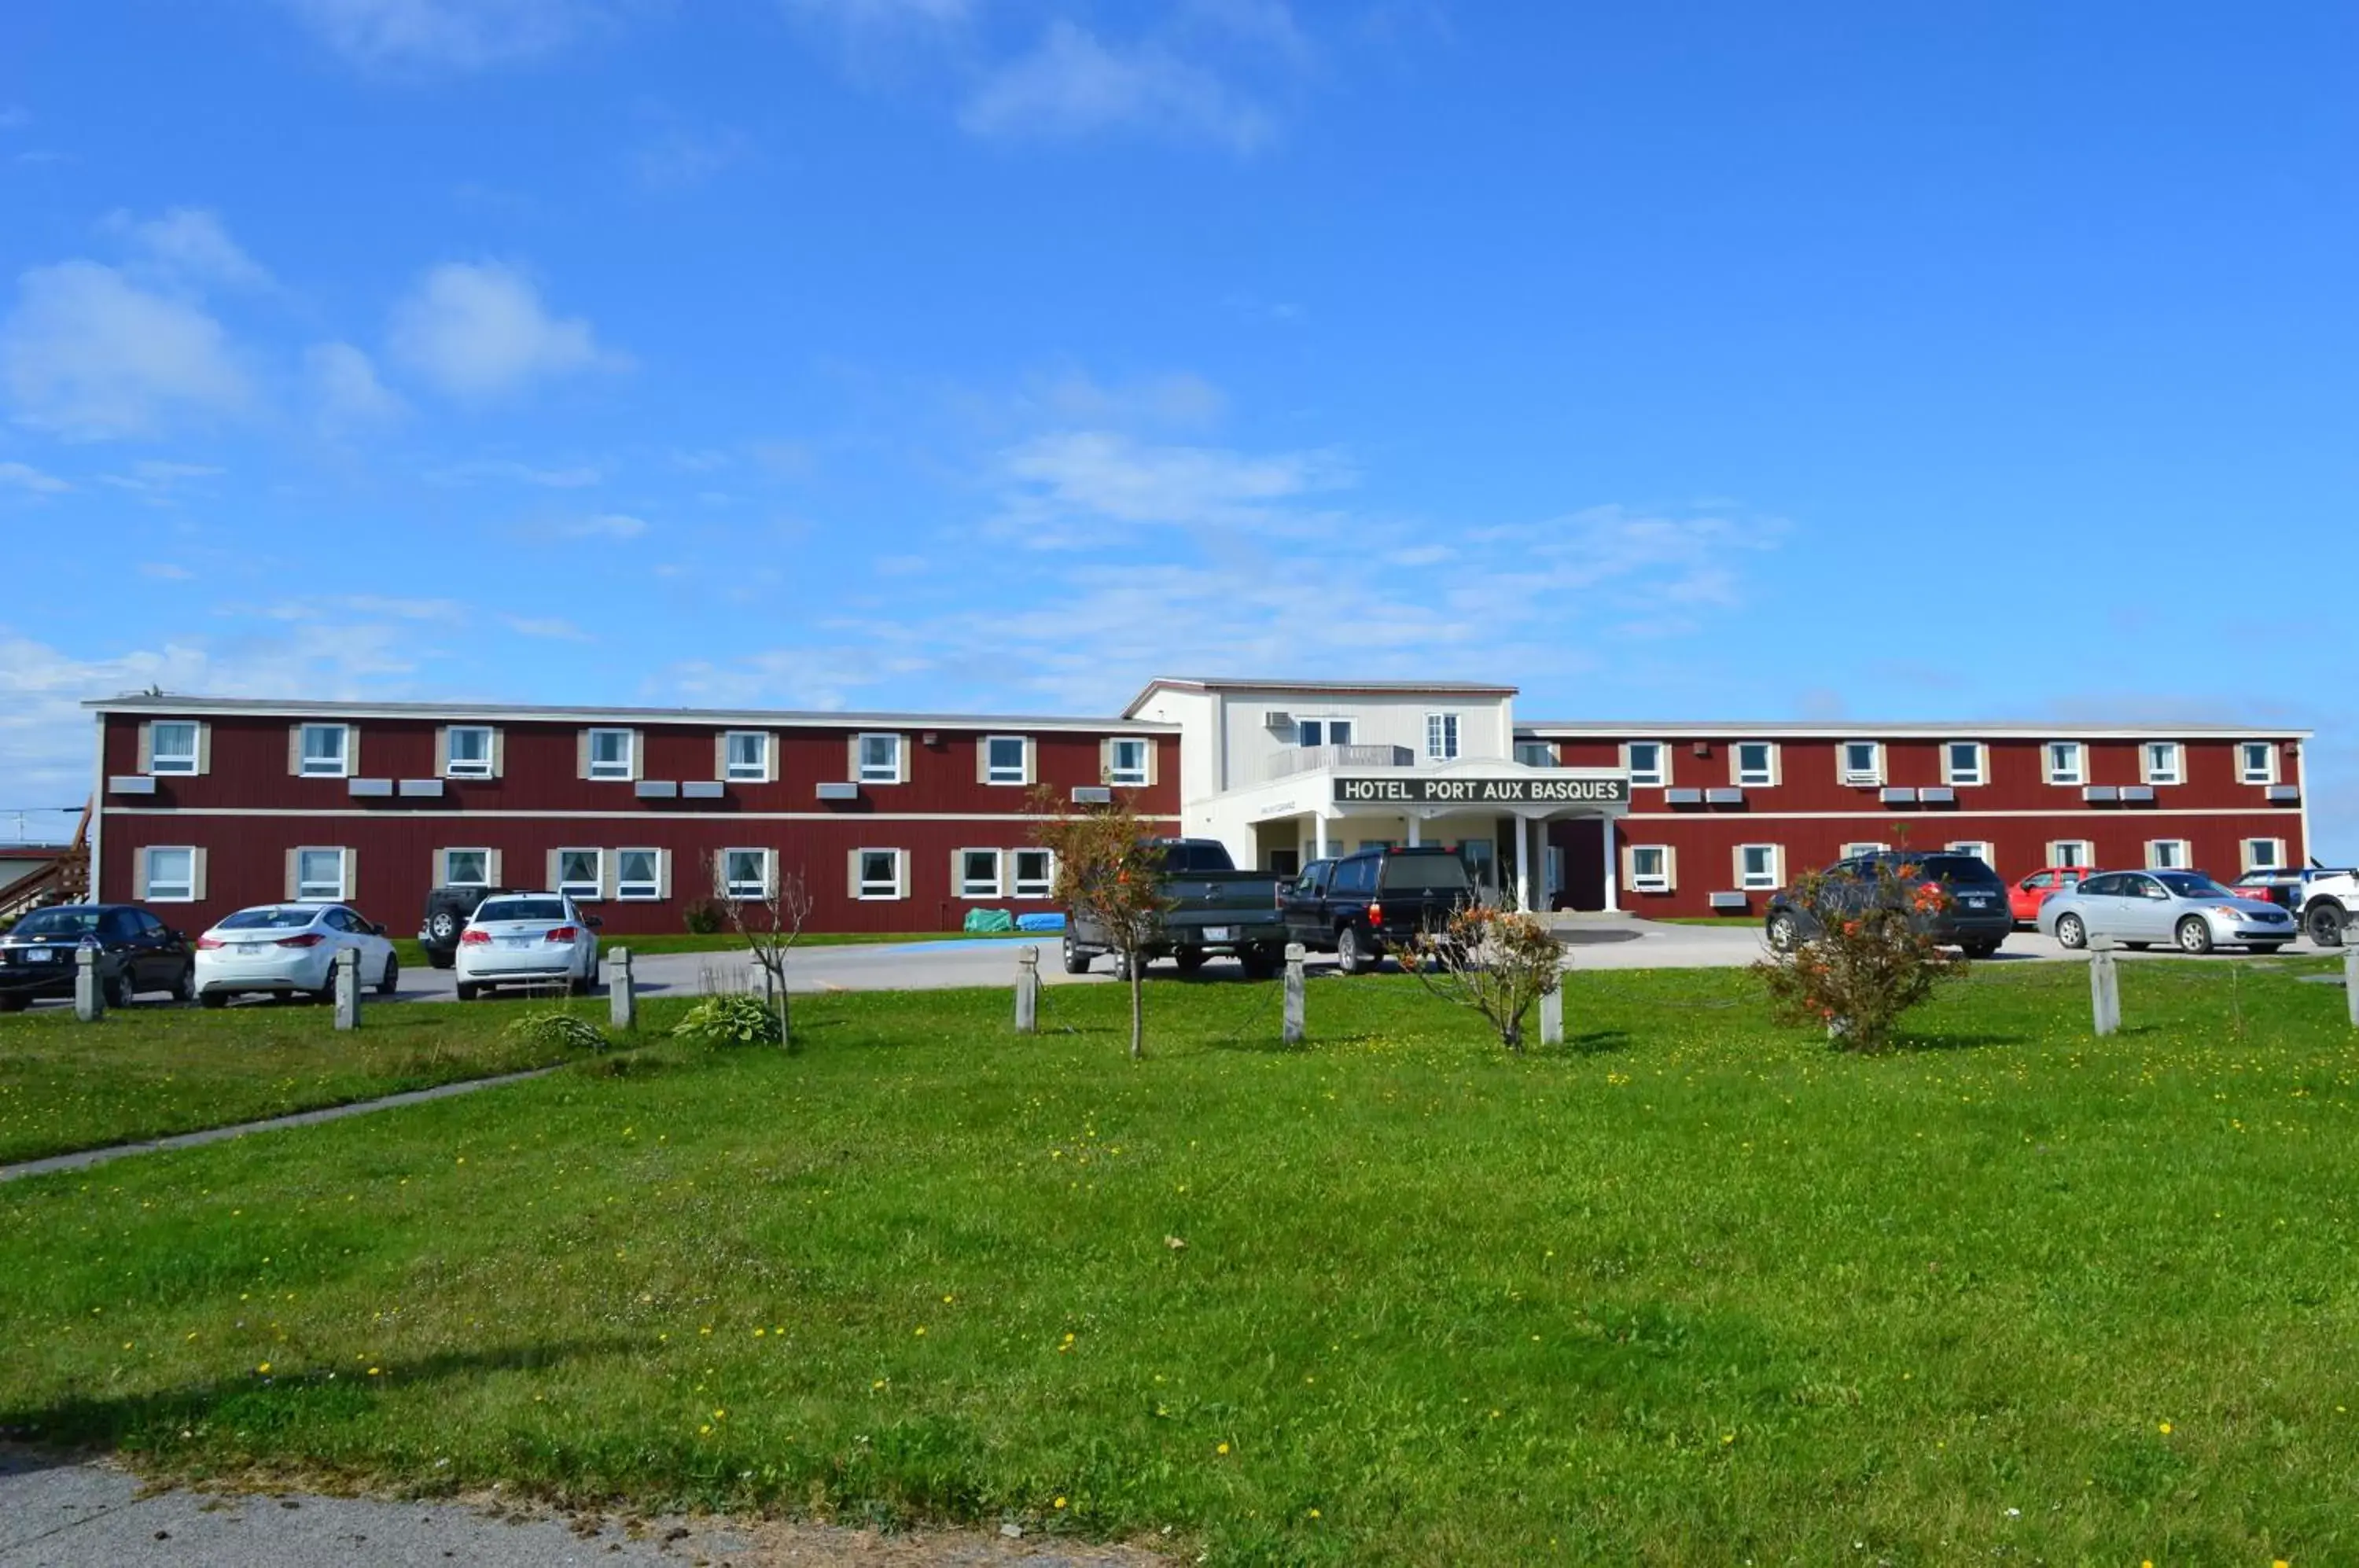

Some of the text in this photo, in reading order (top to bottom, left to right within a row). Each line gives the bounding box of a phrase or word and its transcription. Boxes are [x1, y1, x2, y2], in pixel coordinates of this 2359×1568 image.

[1345, 781, 1619, 800] HOTEL PORT AUX BASQUES
